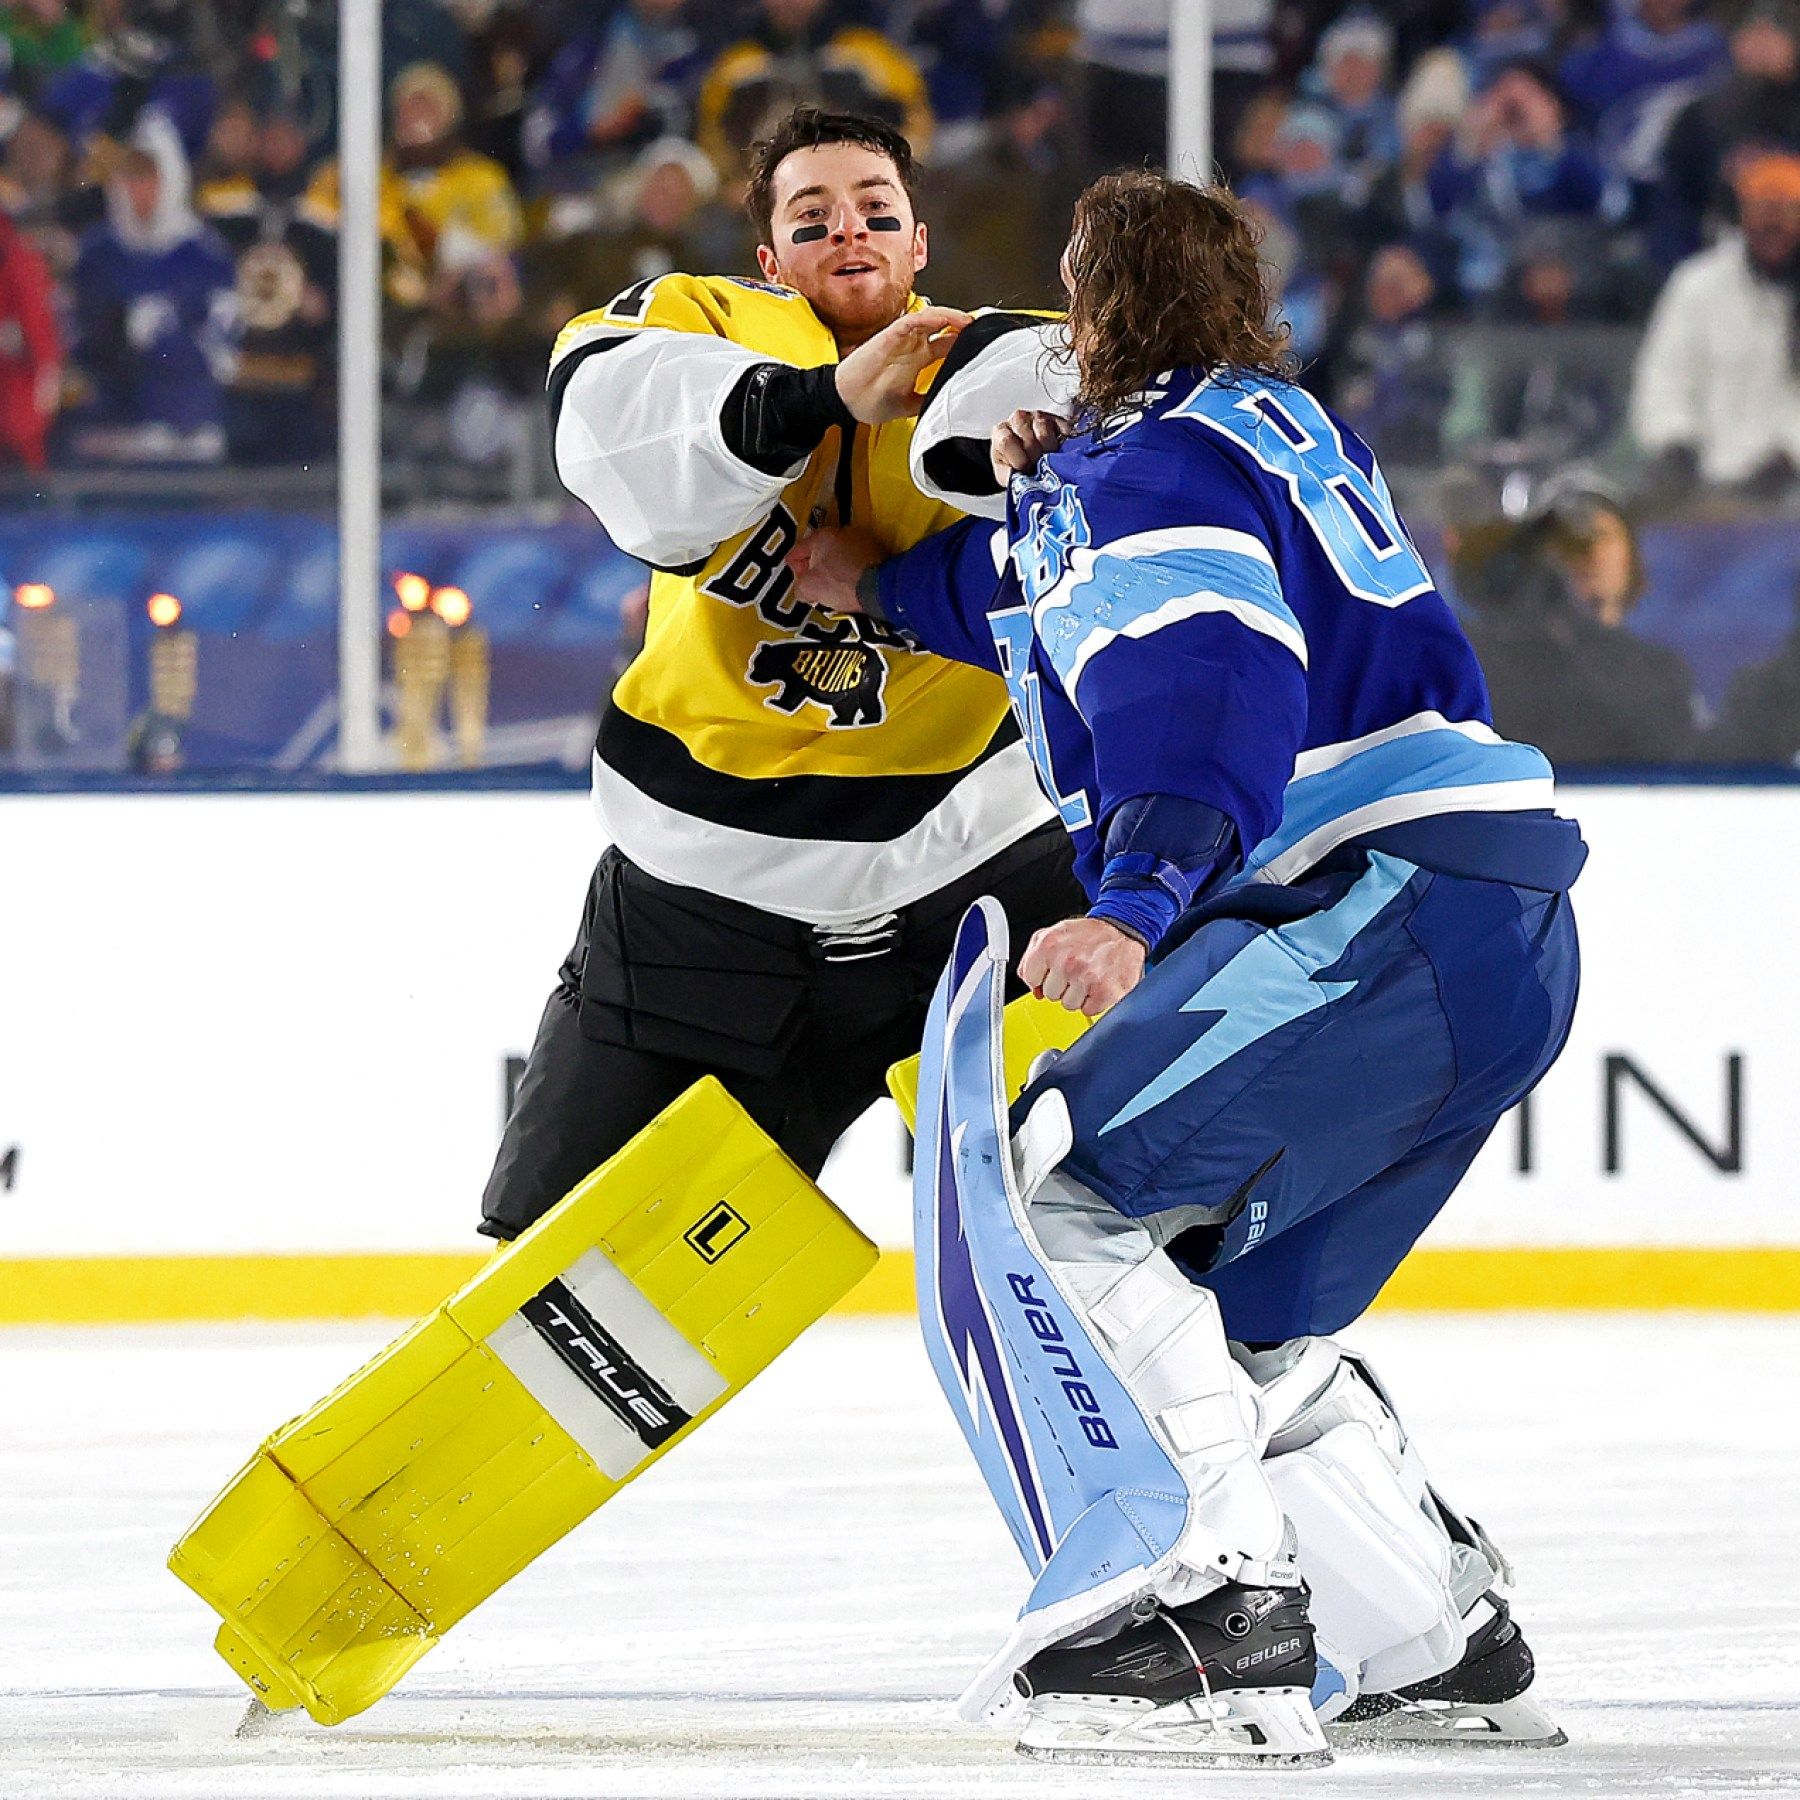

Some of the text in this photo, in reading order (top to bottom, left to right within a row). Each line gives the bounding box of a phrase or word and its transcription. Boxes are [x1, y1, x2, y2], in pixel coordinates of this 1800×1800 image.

[1159, 364, 1436, 609] 8
[792, 649, 867, 693] BRUINS
[693, 1209, 734, 1257] L
[545, 1301, 670, 1429] TRUE
[1005, 1272, 1120, 1451] BAUER
[1236, 1638, 1302, 1670] BAUER
